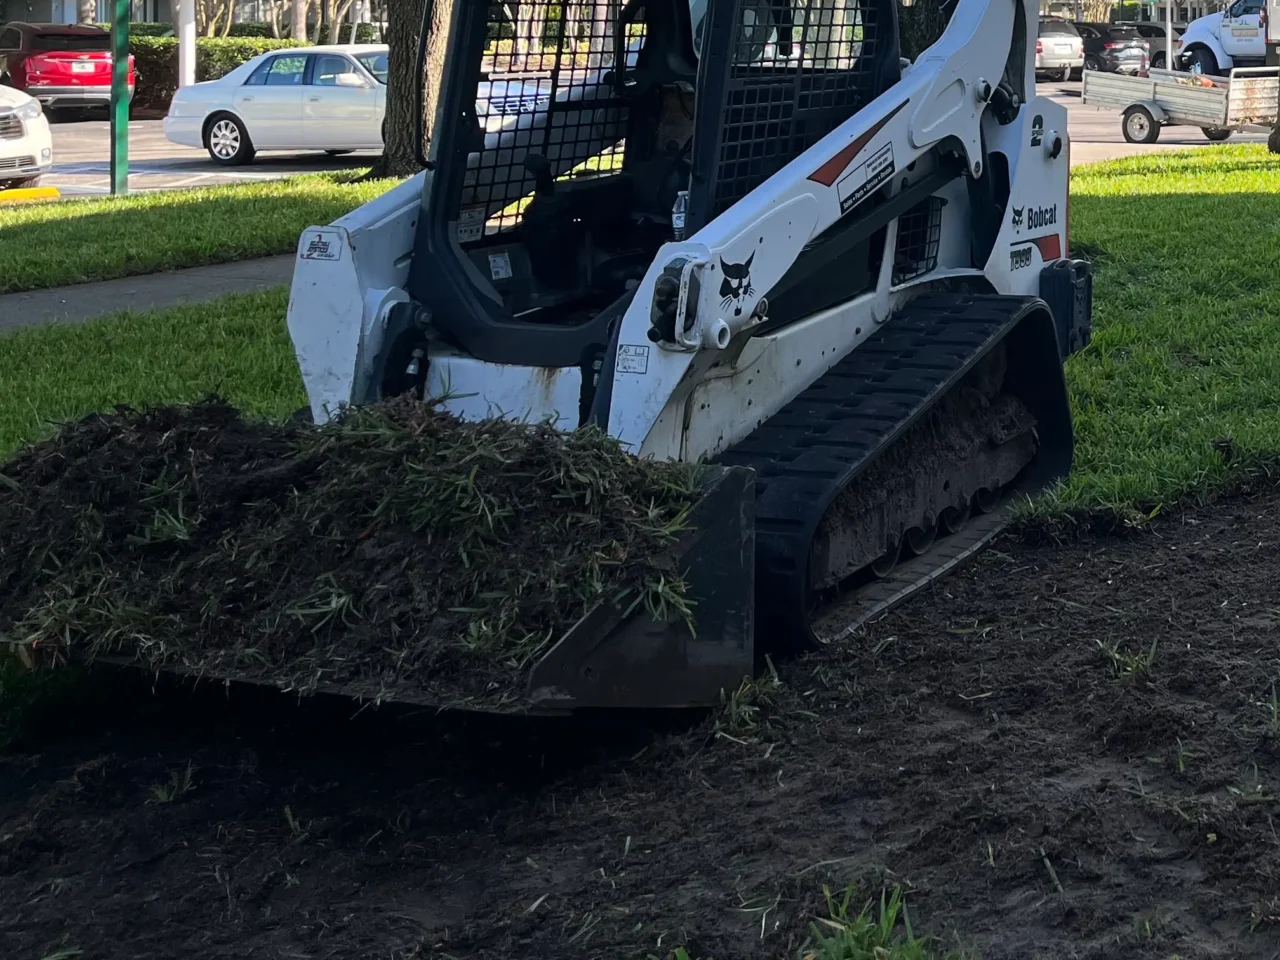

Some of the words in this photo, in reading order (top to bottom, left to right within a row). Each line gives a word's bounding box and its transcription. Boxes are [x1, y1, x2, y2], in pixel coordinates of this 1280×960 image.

[1030, 114, 1044, 147] 2
[866, 178, 879, 191] Service
[1027, 203, 1057, 230] Bobcat
